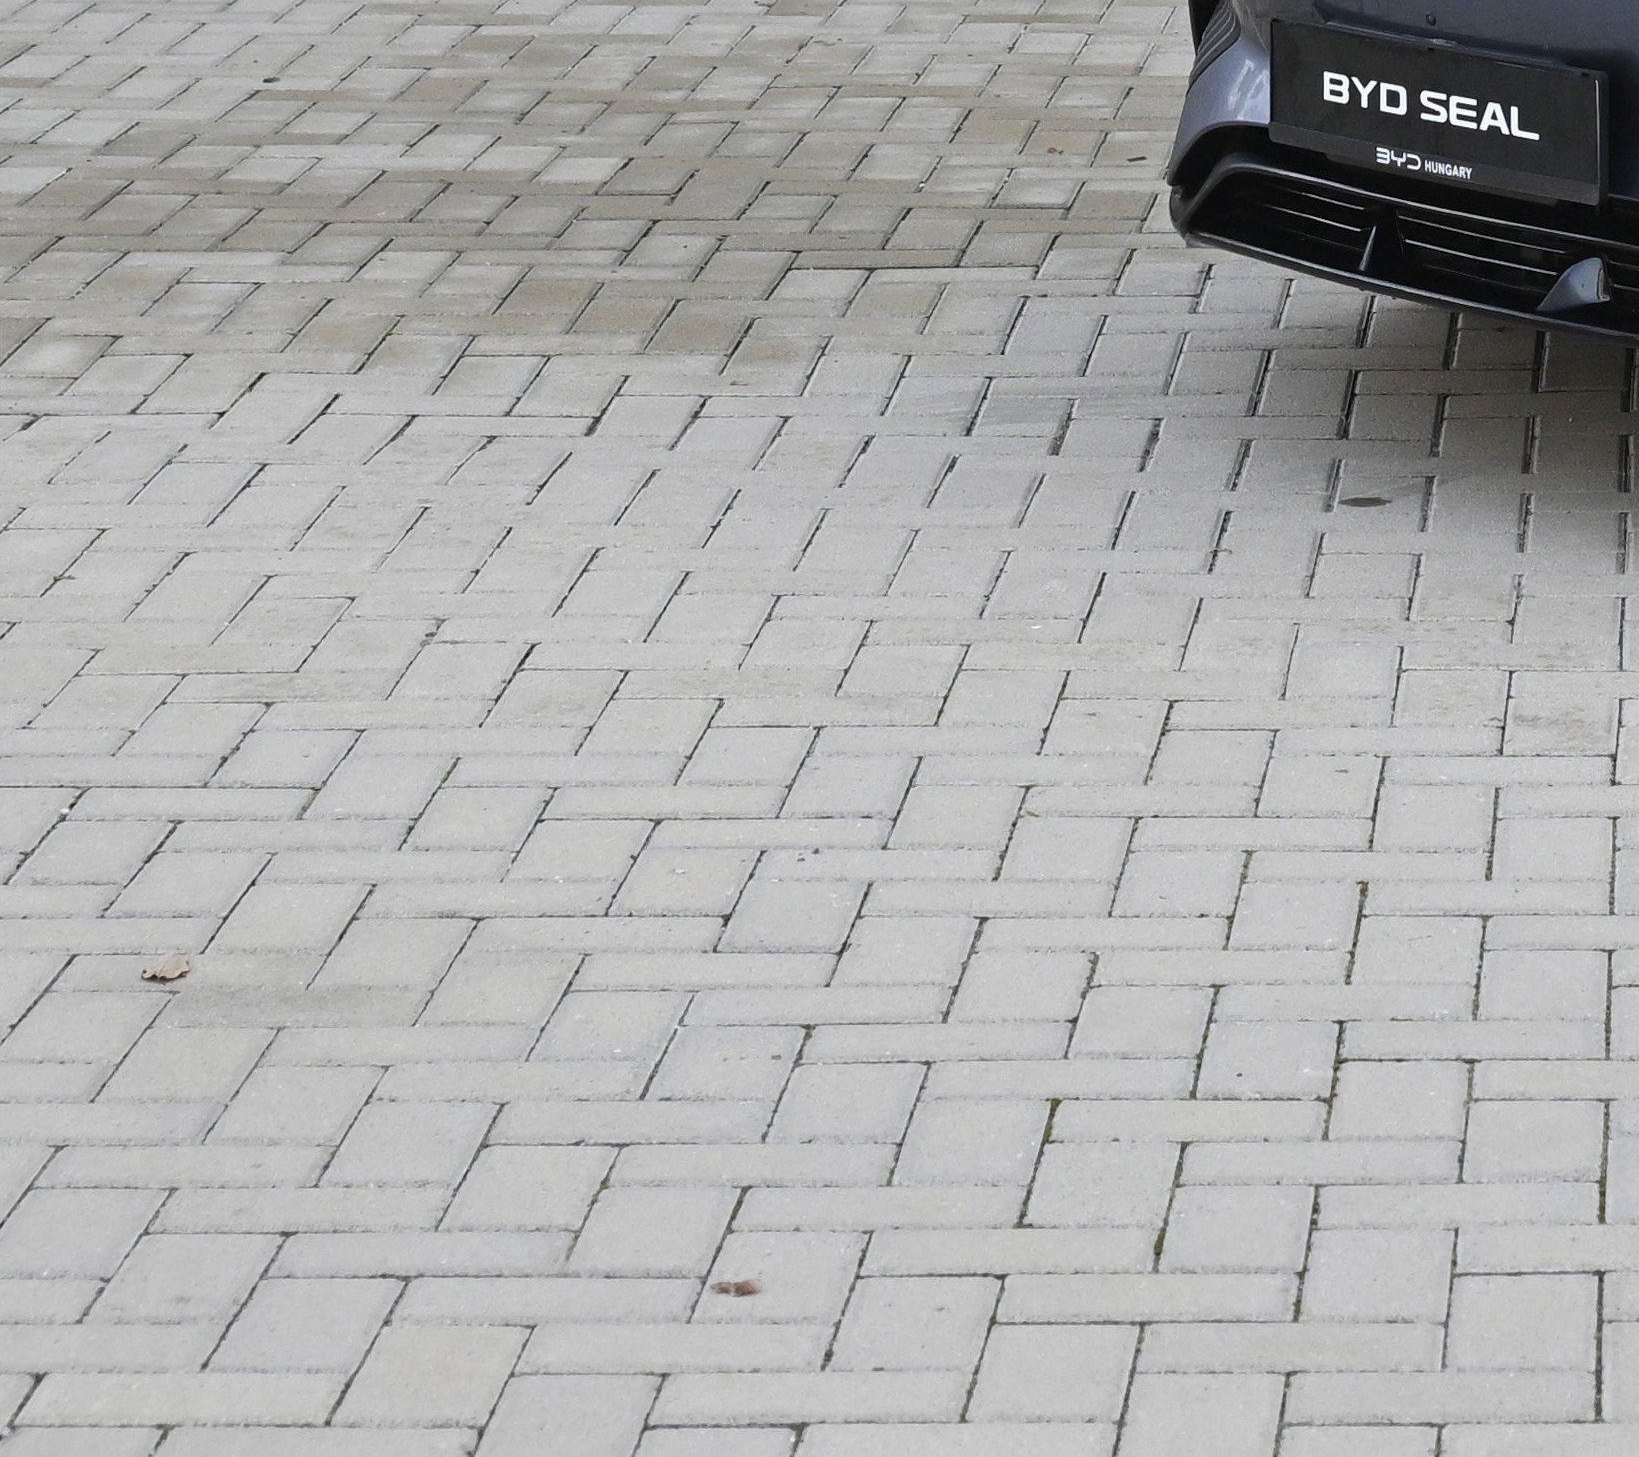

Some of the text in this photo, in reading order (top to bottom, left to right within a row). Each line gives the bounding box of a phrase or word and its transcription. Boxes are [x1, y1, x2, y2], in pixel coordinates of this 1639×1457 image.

[1323, 71, 1540, 141] BYD SEAL
[1376, 147, 1473, 180] BYD HUNGARY
